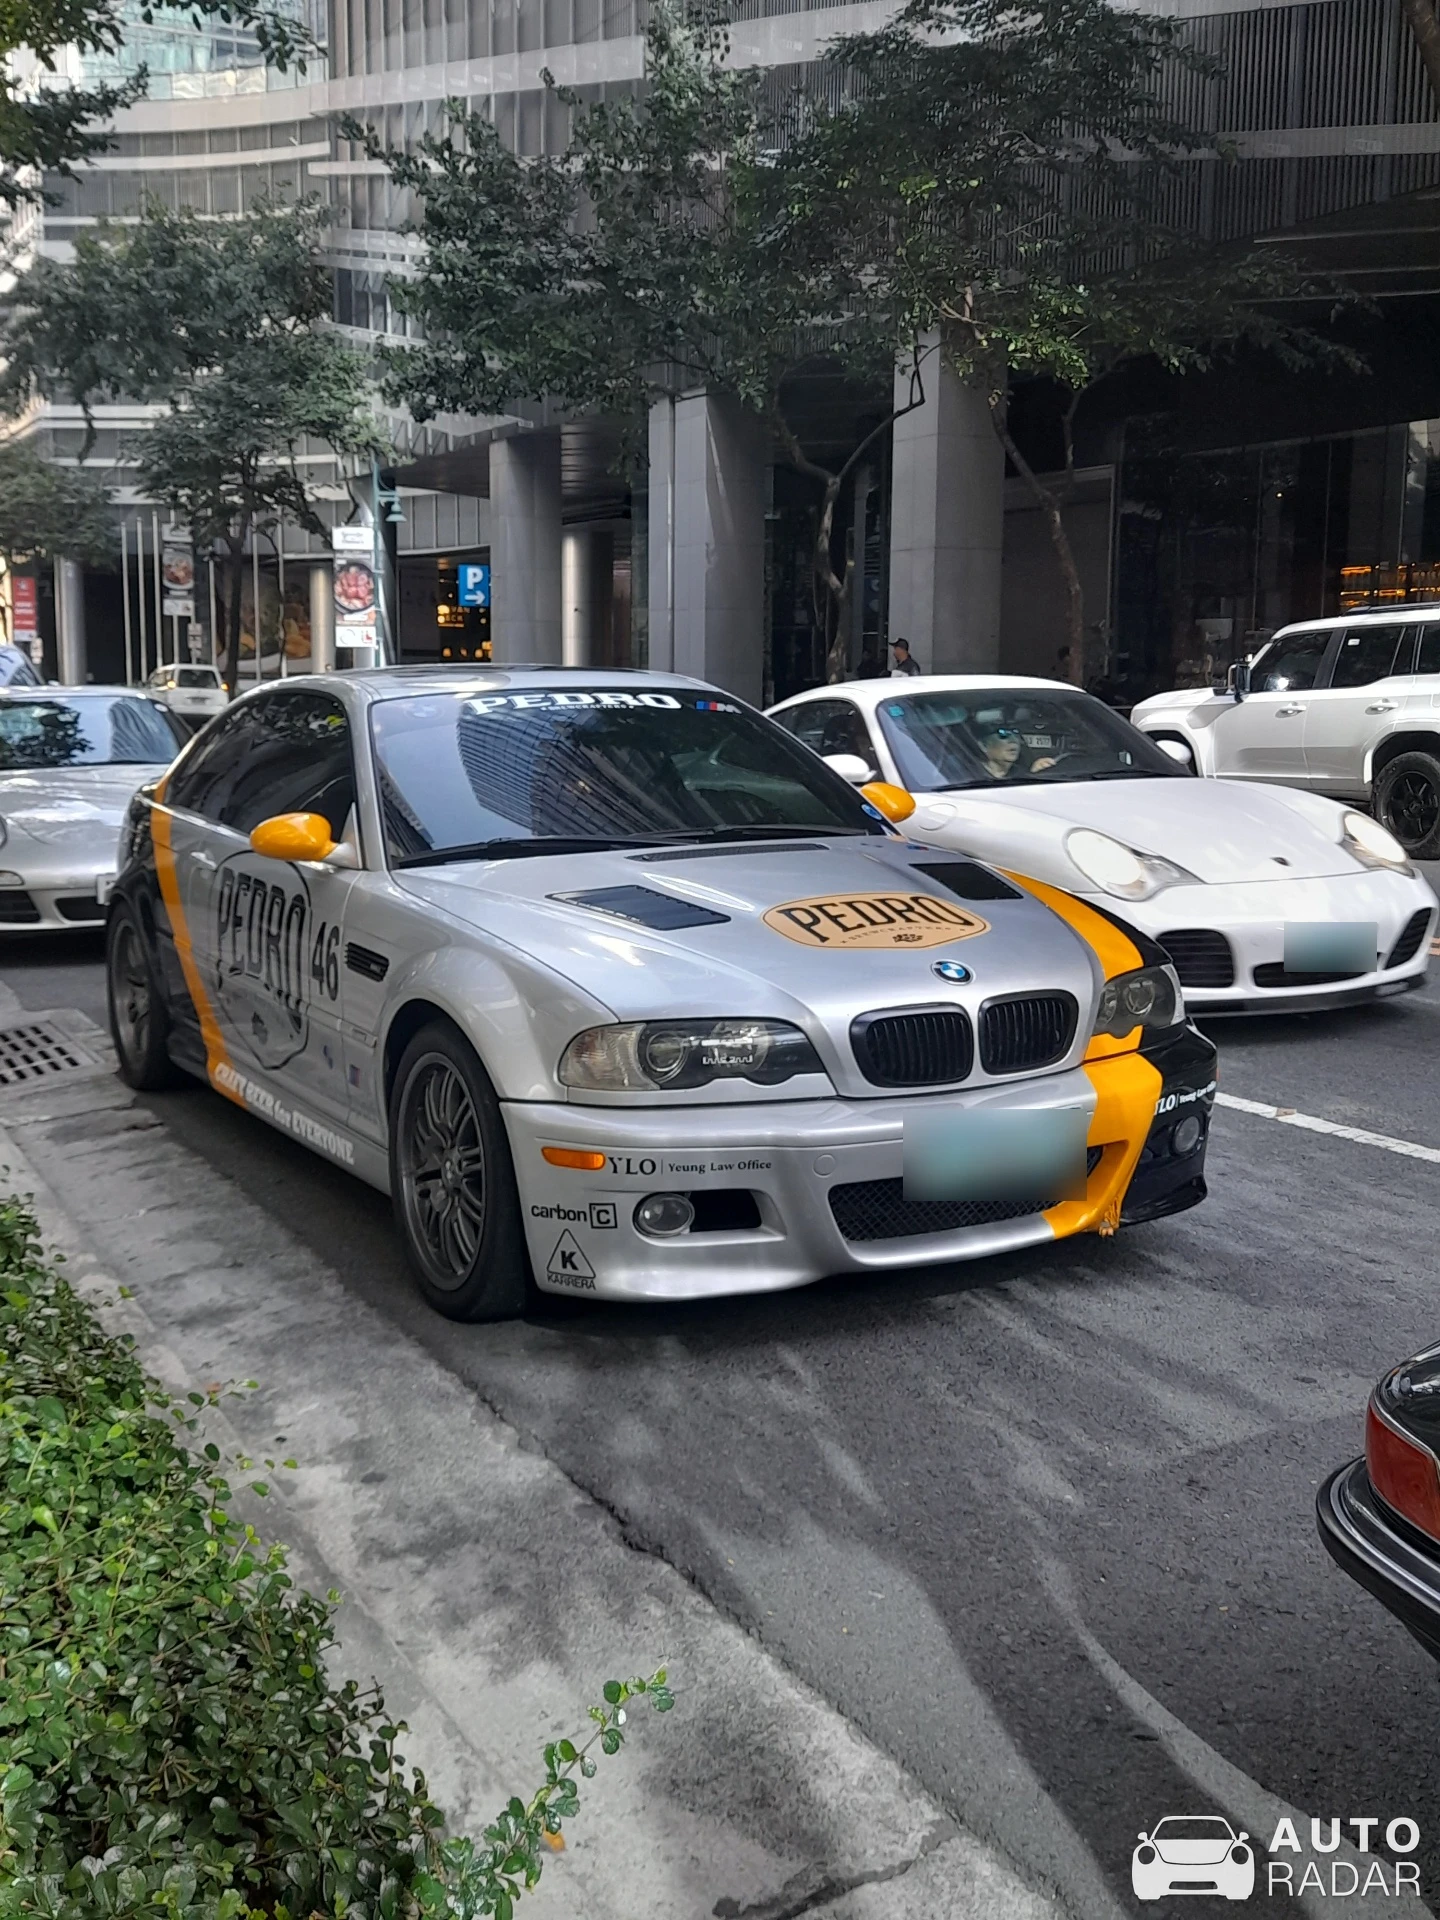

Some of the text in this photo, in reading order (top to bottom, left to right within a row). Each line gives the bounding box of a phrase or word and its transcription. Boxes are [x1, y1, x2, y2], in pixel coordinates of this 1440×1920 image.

[466, 566, 484, 590] P
[464, 693, 682, 715] PEDRO
[775, 896, 975, 943] PEDRO
[216, 866, 307, 1034] PEDRO
[311, 921, 341, 1001] 46
[291, 1109, 355, 1166] EVERYONE
[607, 1156, 772, 1176] YLO Yeung Law Office
[530, 1203, 588, 1223] carbon
[560, 1250, 579, 1271] K
[546, 1273, 597, 1291] KARRERA
